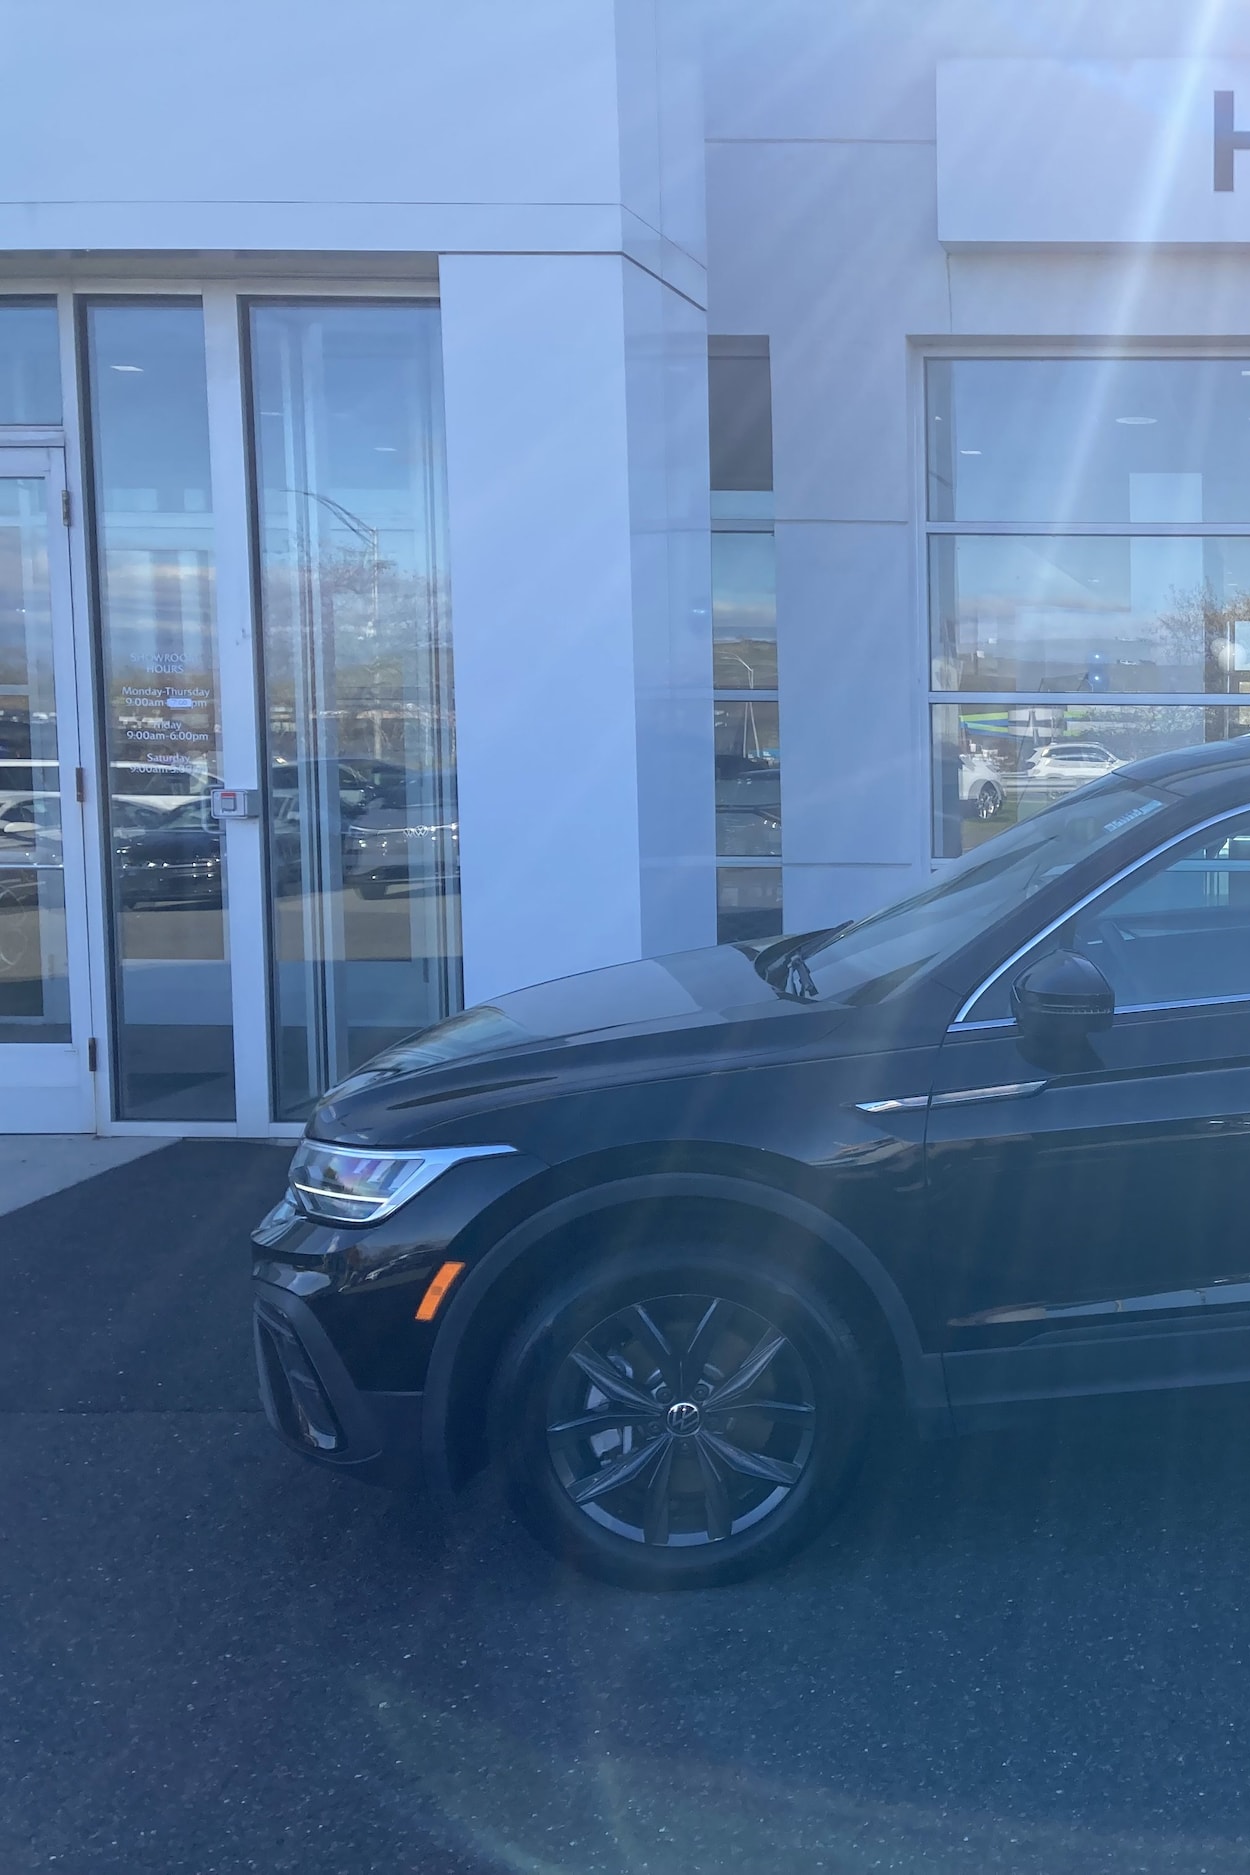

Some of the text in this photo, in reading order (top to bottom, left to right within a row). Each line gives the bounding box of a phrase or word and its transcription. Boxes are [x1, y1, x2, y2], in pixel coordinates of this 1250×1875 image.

[130, 652, 200, 663] SHOWROO
[147, 664, 184, 674] HOURS
[122, 686, 210, 698] Monday-Thursday
[126, 730, 209, 742] 9:00am-6:00pm
[147, 752, 190, 763] Saturday
